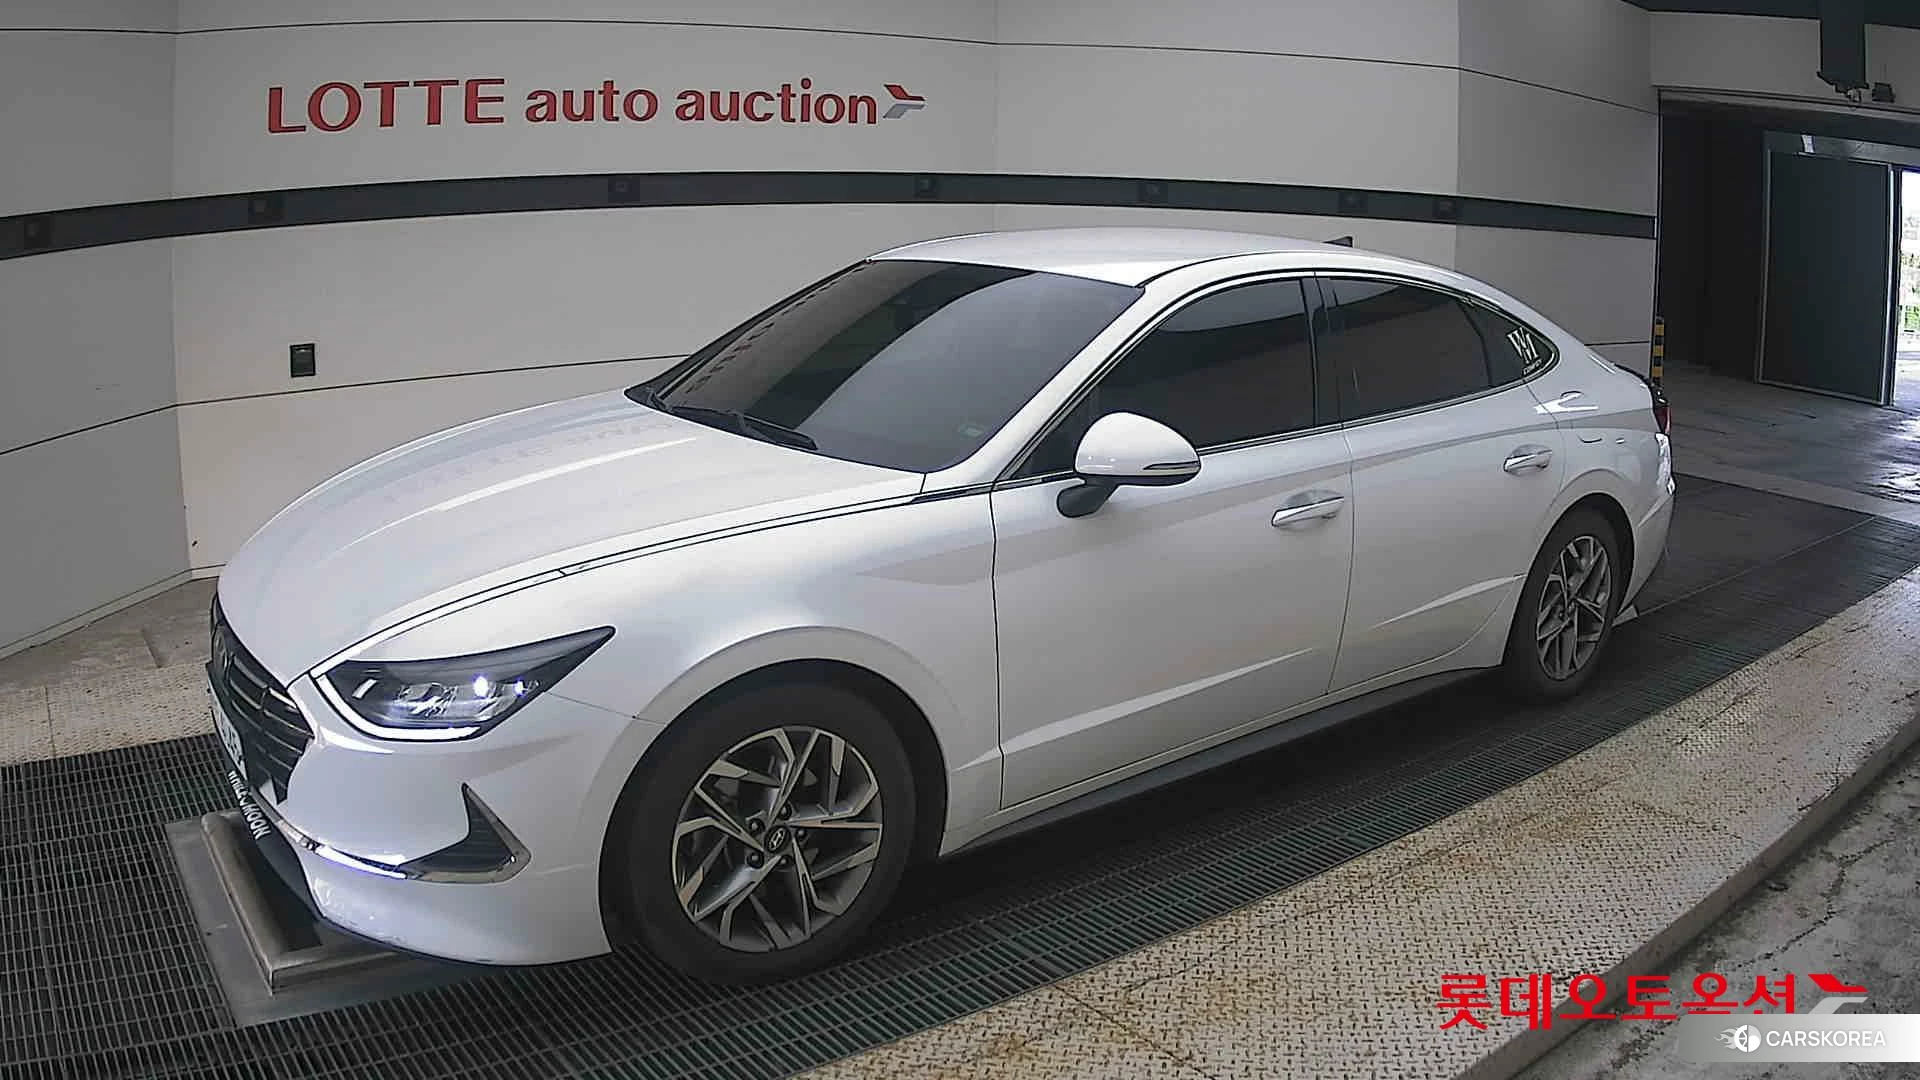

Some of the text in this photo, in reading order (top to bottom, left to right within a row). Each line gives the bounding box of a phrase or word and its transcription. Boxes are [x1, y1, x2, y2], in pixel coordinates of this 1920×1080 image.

[267, 78, 878, 134] LOTTE auto auction
